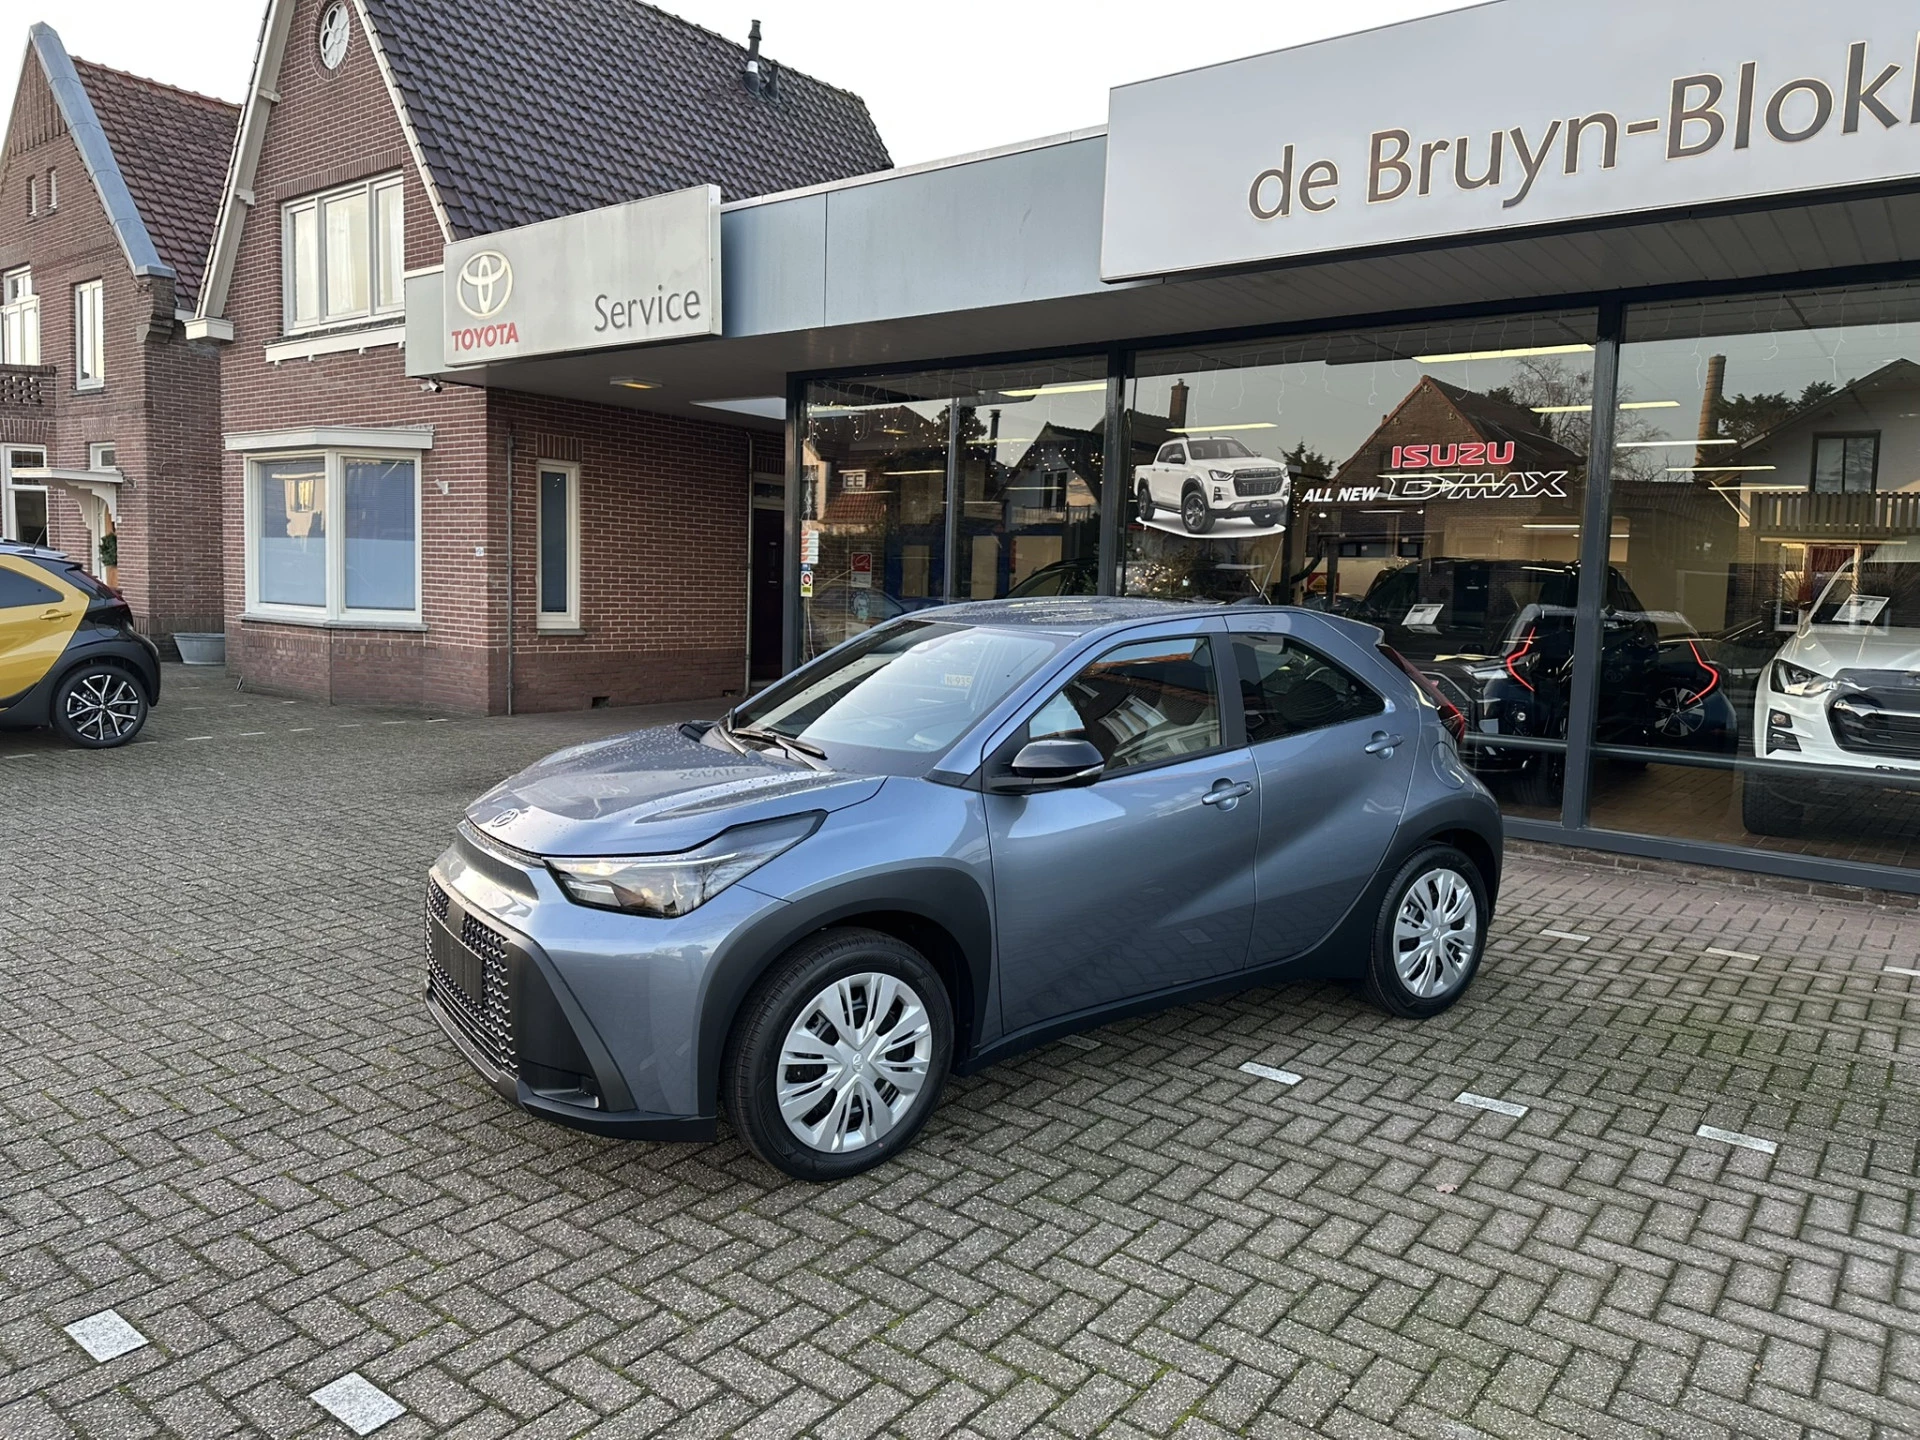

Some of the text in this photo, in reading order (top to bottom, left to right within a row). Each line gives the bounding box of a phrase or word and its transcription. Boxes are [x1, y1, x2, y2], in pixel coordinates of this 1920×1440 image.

[1248, 144, 1339, 221] de
[594, 284, 701, 333] Service
[451, 322, 519, 351] TOYOTA
[1391, 441, 1515, 469] ISUZU
[1301, 488, 1335, 503] ALL
[1336, 486, 1381, 502] NEW
